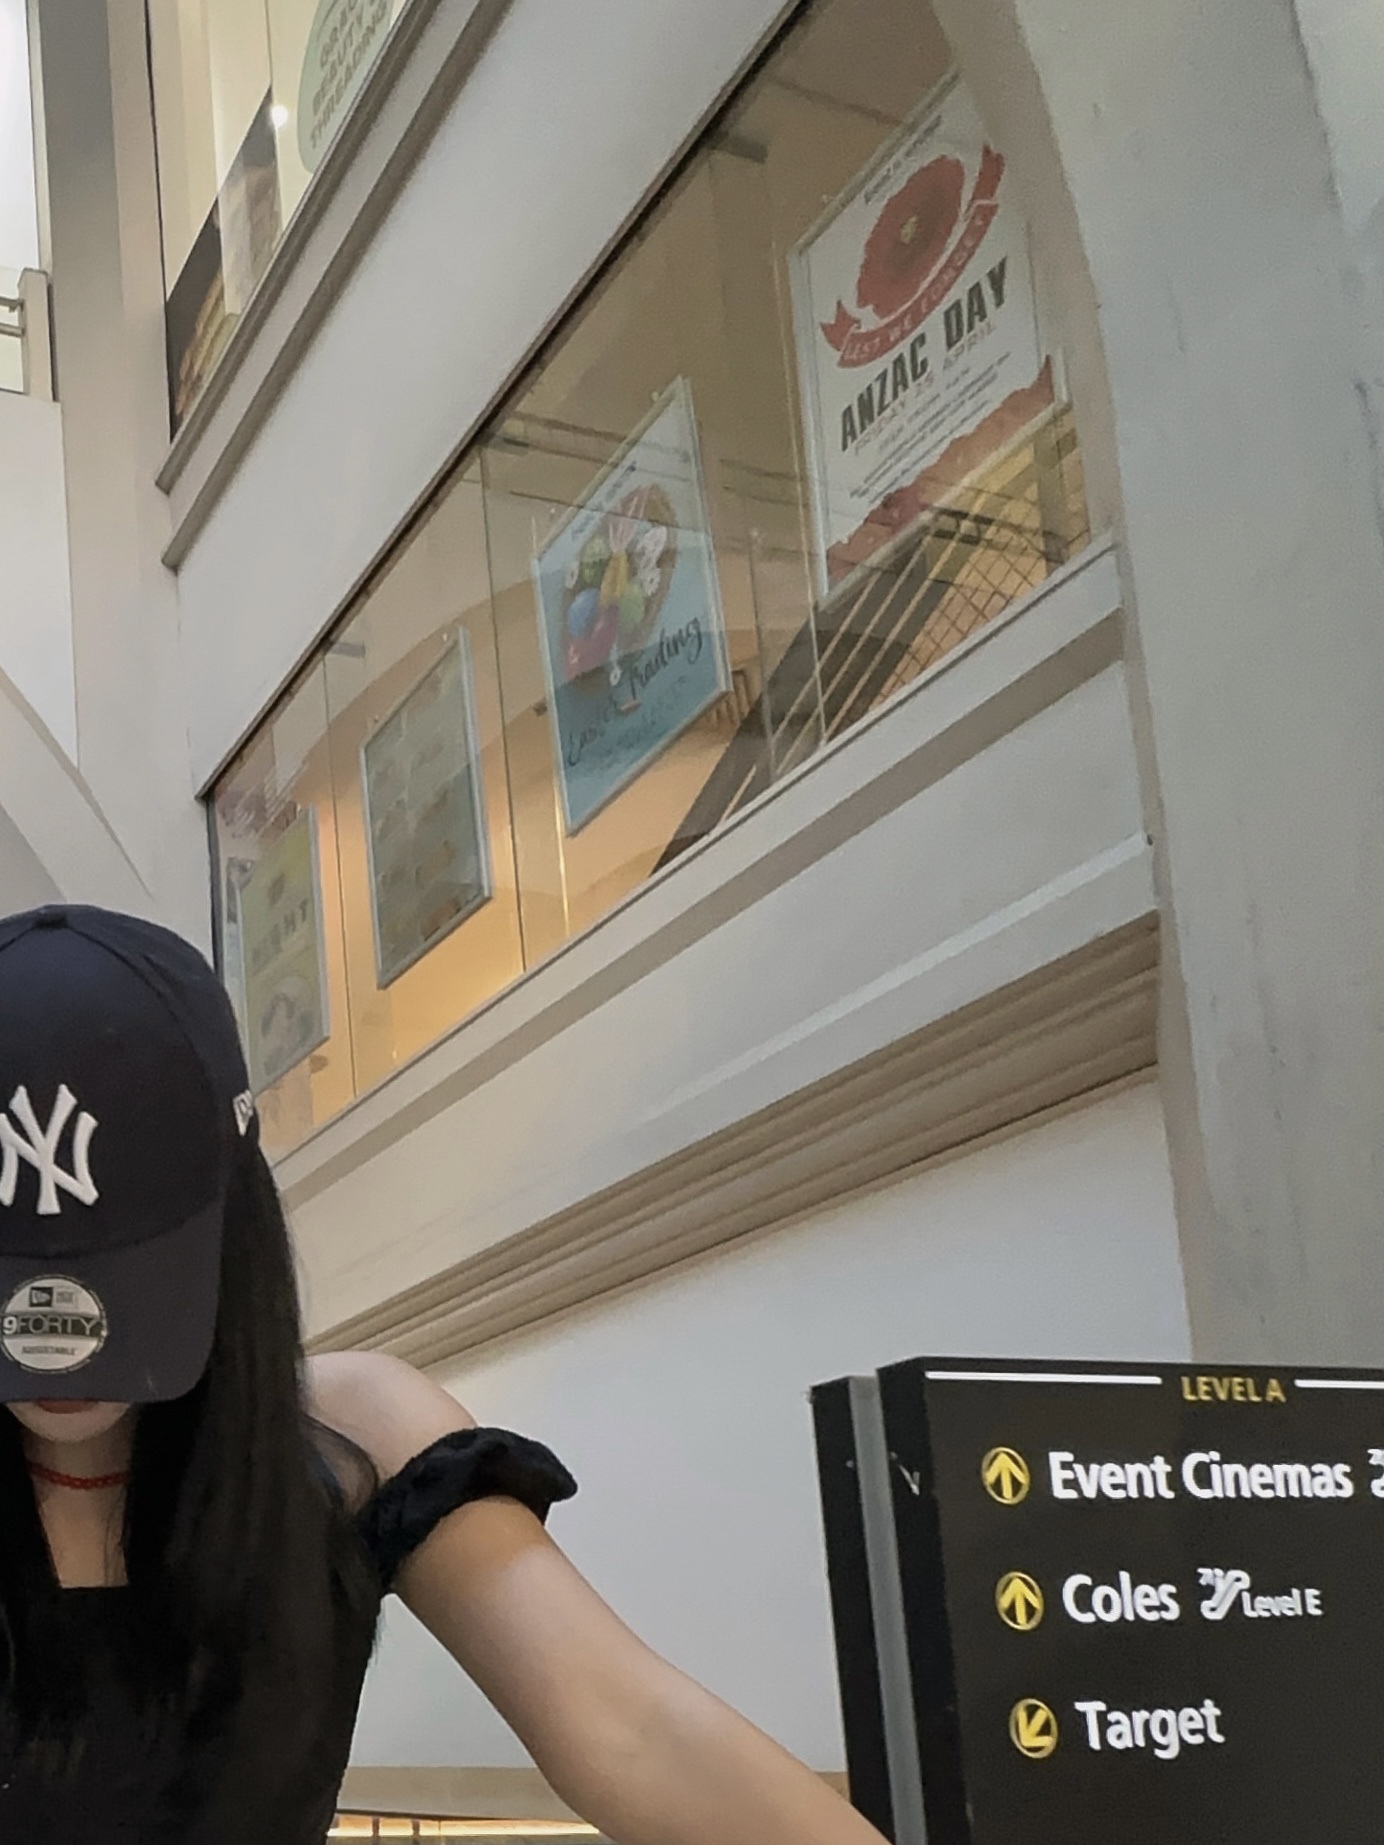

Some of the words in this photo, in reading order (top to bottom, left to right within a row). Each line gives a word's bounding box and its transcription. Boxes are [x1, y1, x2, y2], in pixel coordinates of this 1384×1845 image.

[841, 332, 929, 453] ANZAC
[943, 255, 1007, 351] DAY
[2, 1315, 97, 1336] 9FORTY
[1180, 1375, 1263, 1402] LEVEL
[1265, 1378, 1287, 1403] A
[1048, 1451, 1176, 1500] Event
[1181, 1450, 1355, 1499] Cinemas
[1062, 1570, 1180, 1623] Coles
[1242, 1588, 1303, 1618] Level
[1304, 1588, 1324, 1616] E
[1074, 1699, 1226, 1760] Target
